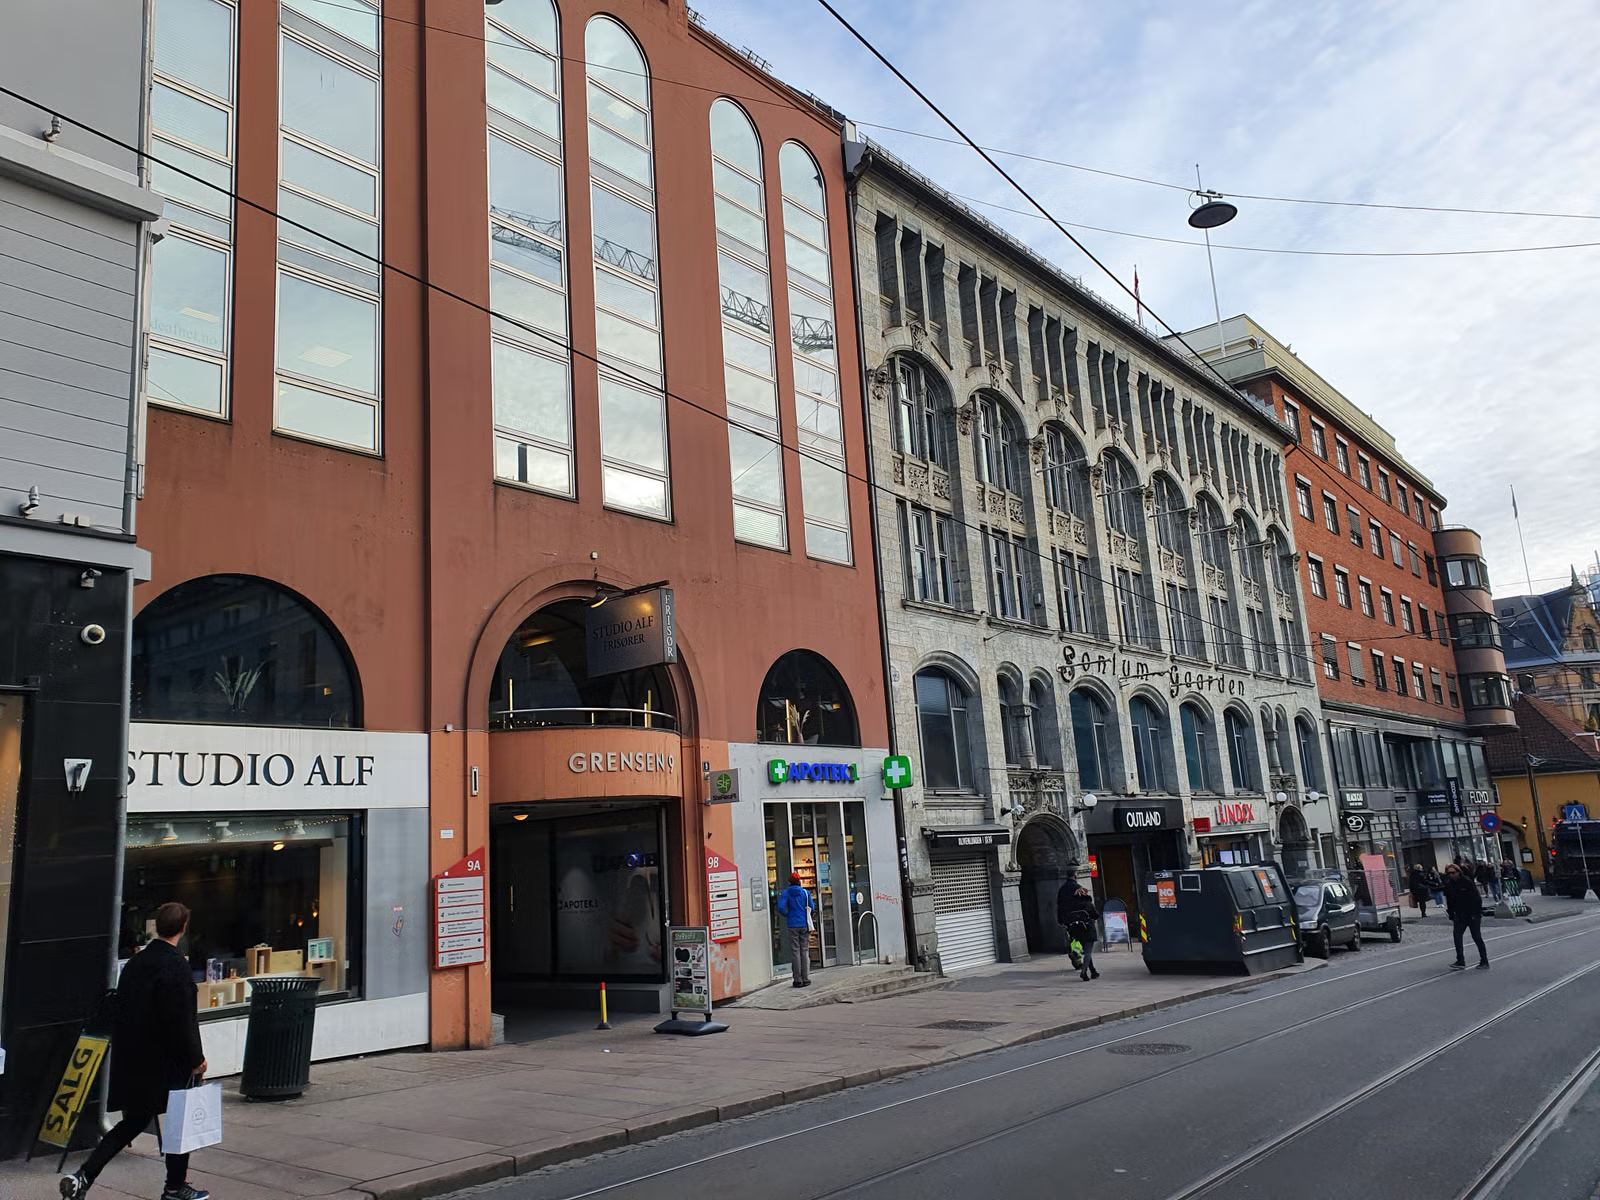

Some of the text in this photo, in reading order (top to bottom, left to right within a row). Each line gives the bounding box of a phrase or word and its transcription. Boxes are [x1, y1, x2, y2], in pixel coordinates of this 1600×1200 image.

[593, 616, 654, 640] STUDIO ALF
[665, 594, 674, 657] FRISØR
[304, 754, 375, 787] ALF
[568, 752, 675, 774] GRENSEN 9
[788, 762, 849, 782] APOTEK
[1126, 811, 1162, 828] OUTLAND
[1215, 802, 1255, 824] LINDEX
[467, 860, 481, 871] 9A
[708, 857, 719, 869] 9B
[564, 899, 594, 909] APOTEK
[46, 1048, 93, 1133] SALG
